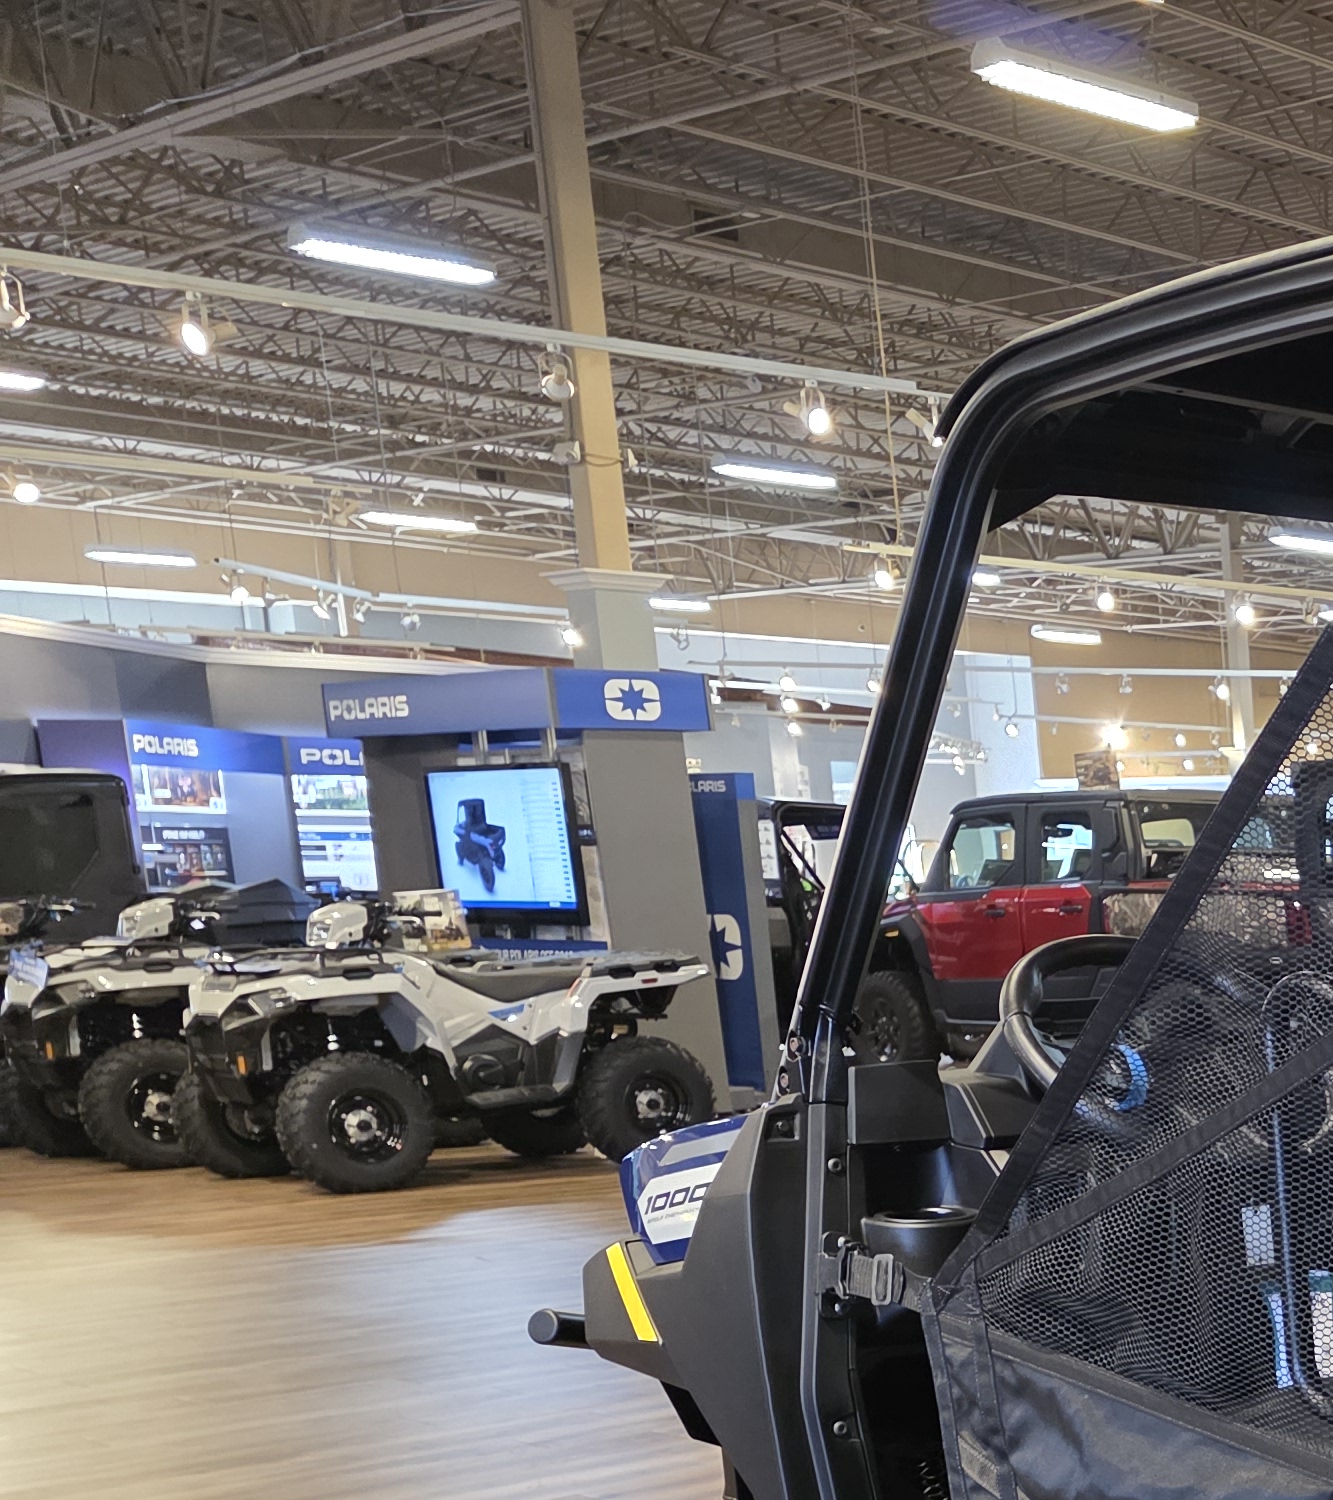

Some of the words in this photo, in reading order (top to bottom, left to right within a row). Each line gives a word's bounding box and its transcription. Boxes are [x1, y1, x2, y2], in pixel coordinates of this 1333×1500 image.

[329, 695, 409, 721] POLARIS
[133, 734, 199, 757] POLARIS
[300, 748, 364, 765] POL
[690, 779, 727, 793] LARIS
